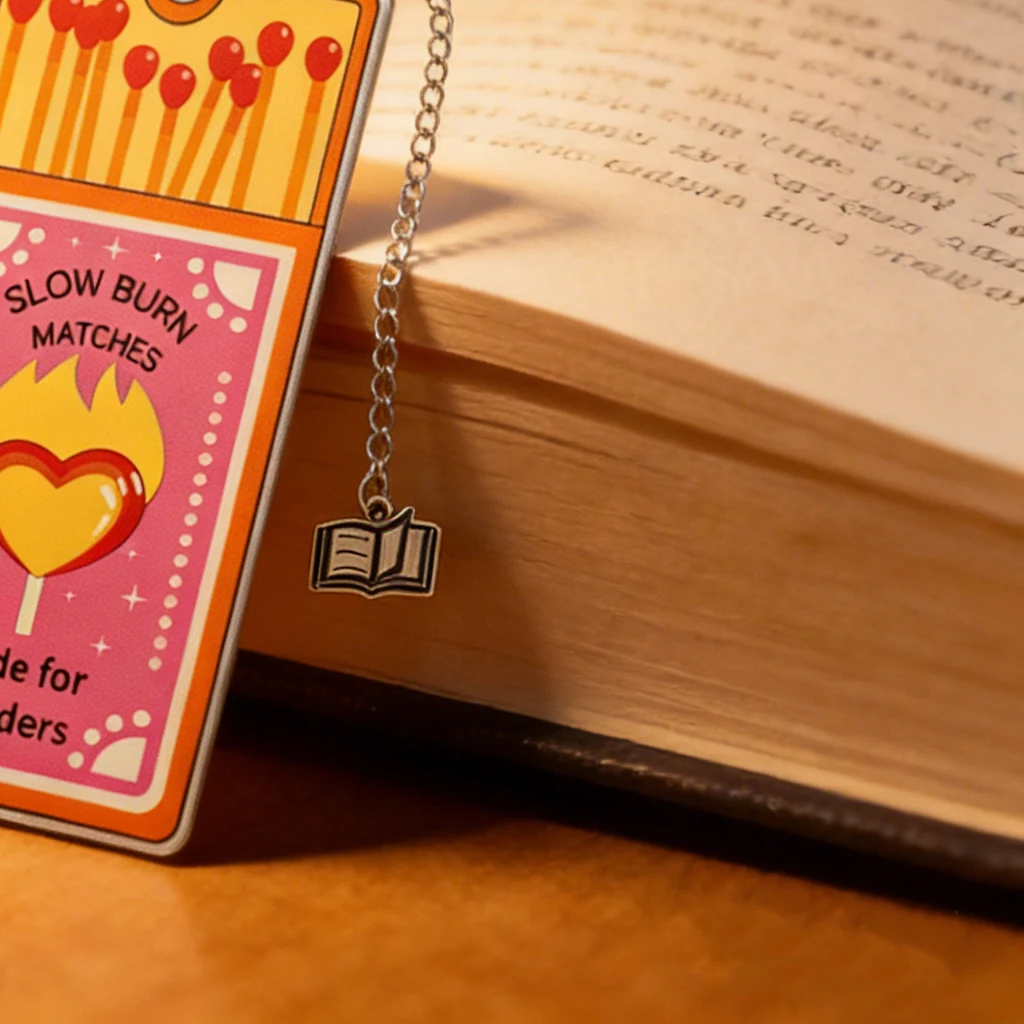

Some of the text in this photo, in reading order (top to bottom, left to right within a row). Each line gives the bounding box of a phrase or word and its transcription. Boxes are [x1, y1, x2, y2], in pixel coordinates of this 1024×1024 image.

[4, 268, 198, 345] SLOW BURN
[31, 320, 163, 372] MATCHES
[38, 656, 88, 695] for
